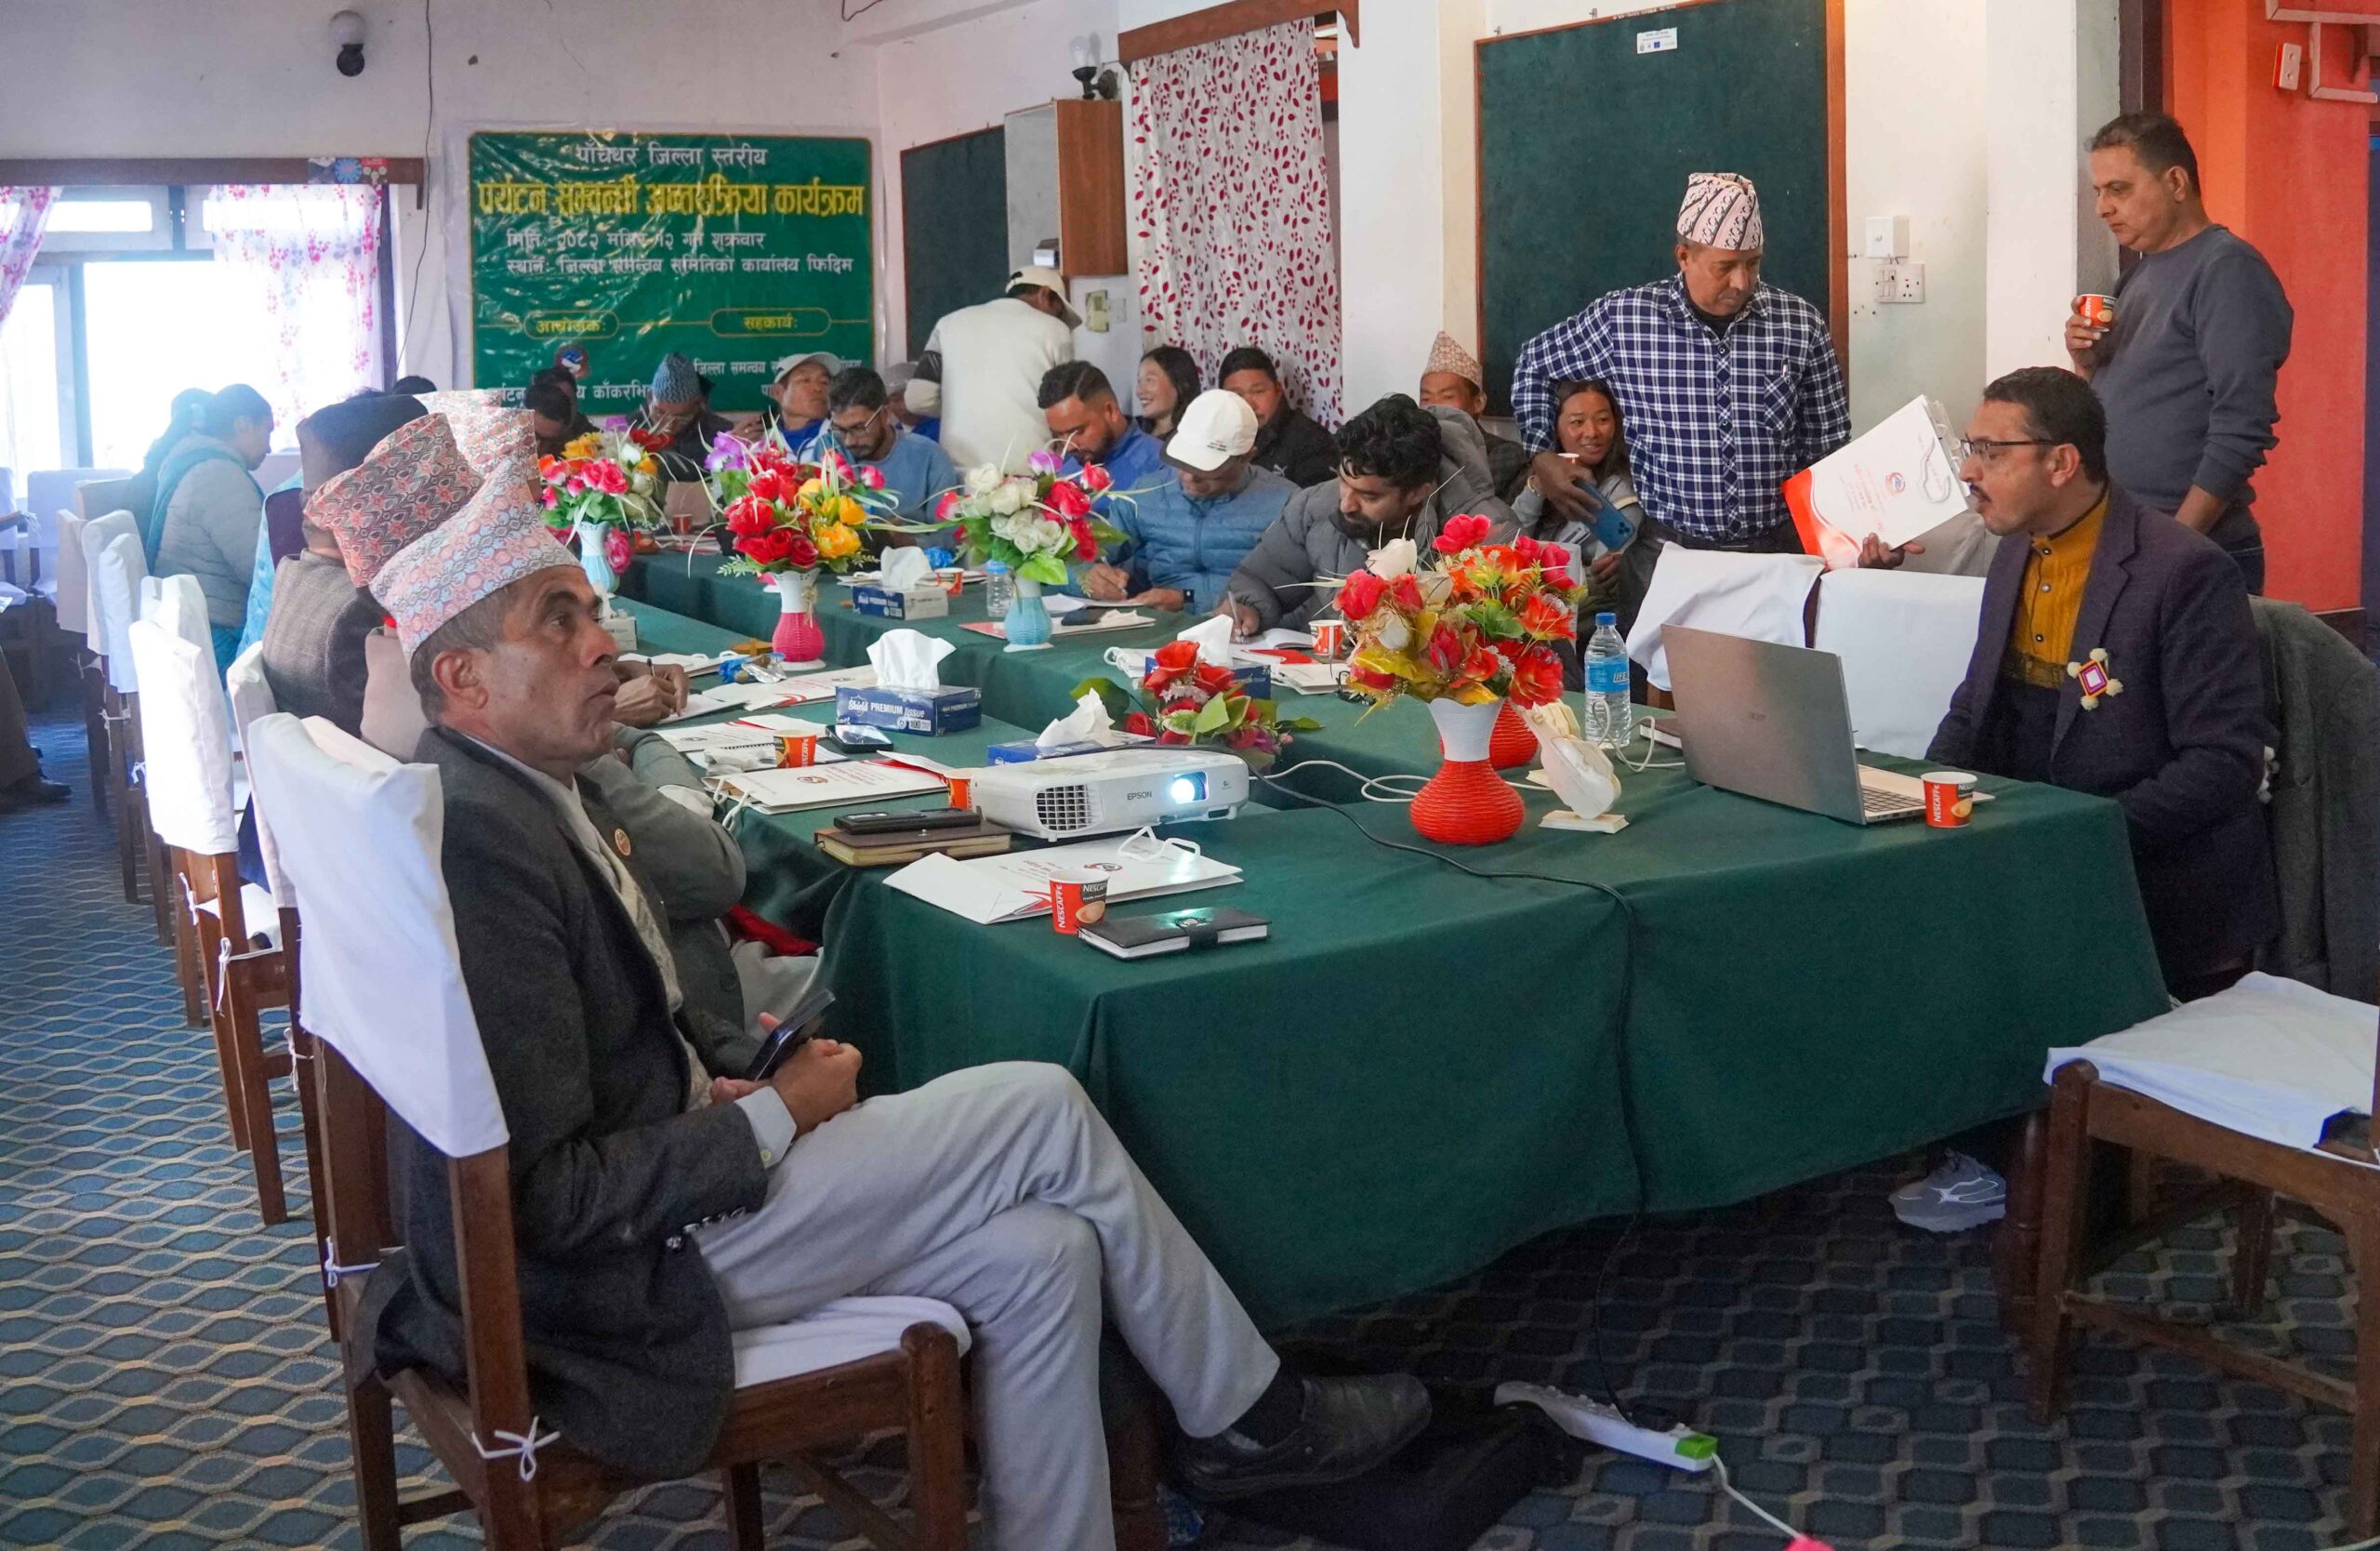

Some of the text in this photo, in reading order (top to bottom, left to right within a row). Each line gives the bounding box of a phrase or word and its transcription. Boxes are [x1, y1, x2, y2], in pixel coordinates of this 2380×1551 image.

[576, 141, 768, 168] पाँचथर जिल्ला स्तरीय
[478, 174, 549, 215] पर्यटन
[774, 177, 865, 217] कार्यक्रम
[711, 232, 767, 253] शुक्रवार
[557, 254, 606, 275] जिल्ला
[671, 253, 735, 276] समितिको
[741, 254, 800, 272] कार्यालय
[807, 253, 854, 273] फिदिम
[694, 357, 725, 376] जिल्ला
[731, 361, 766, 376] समन्वय
[870, 702, 904, 715] PREMIUM
[905, 707, 925, 718] tissue
[1127, 790, 1152, 801] EPSON
